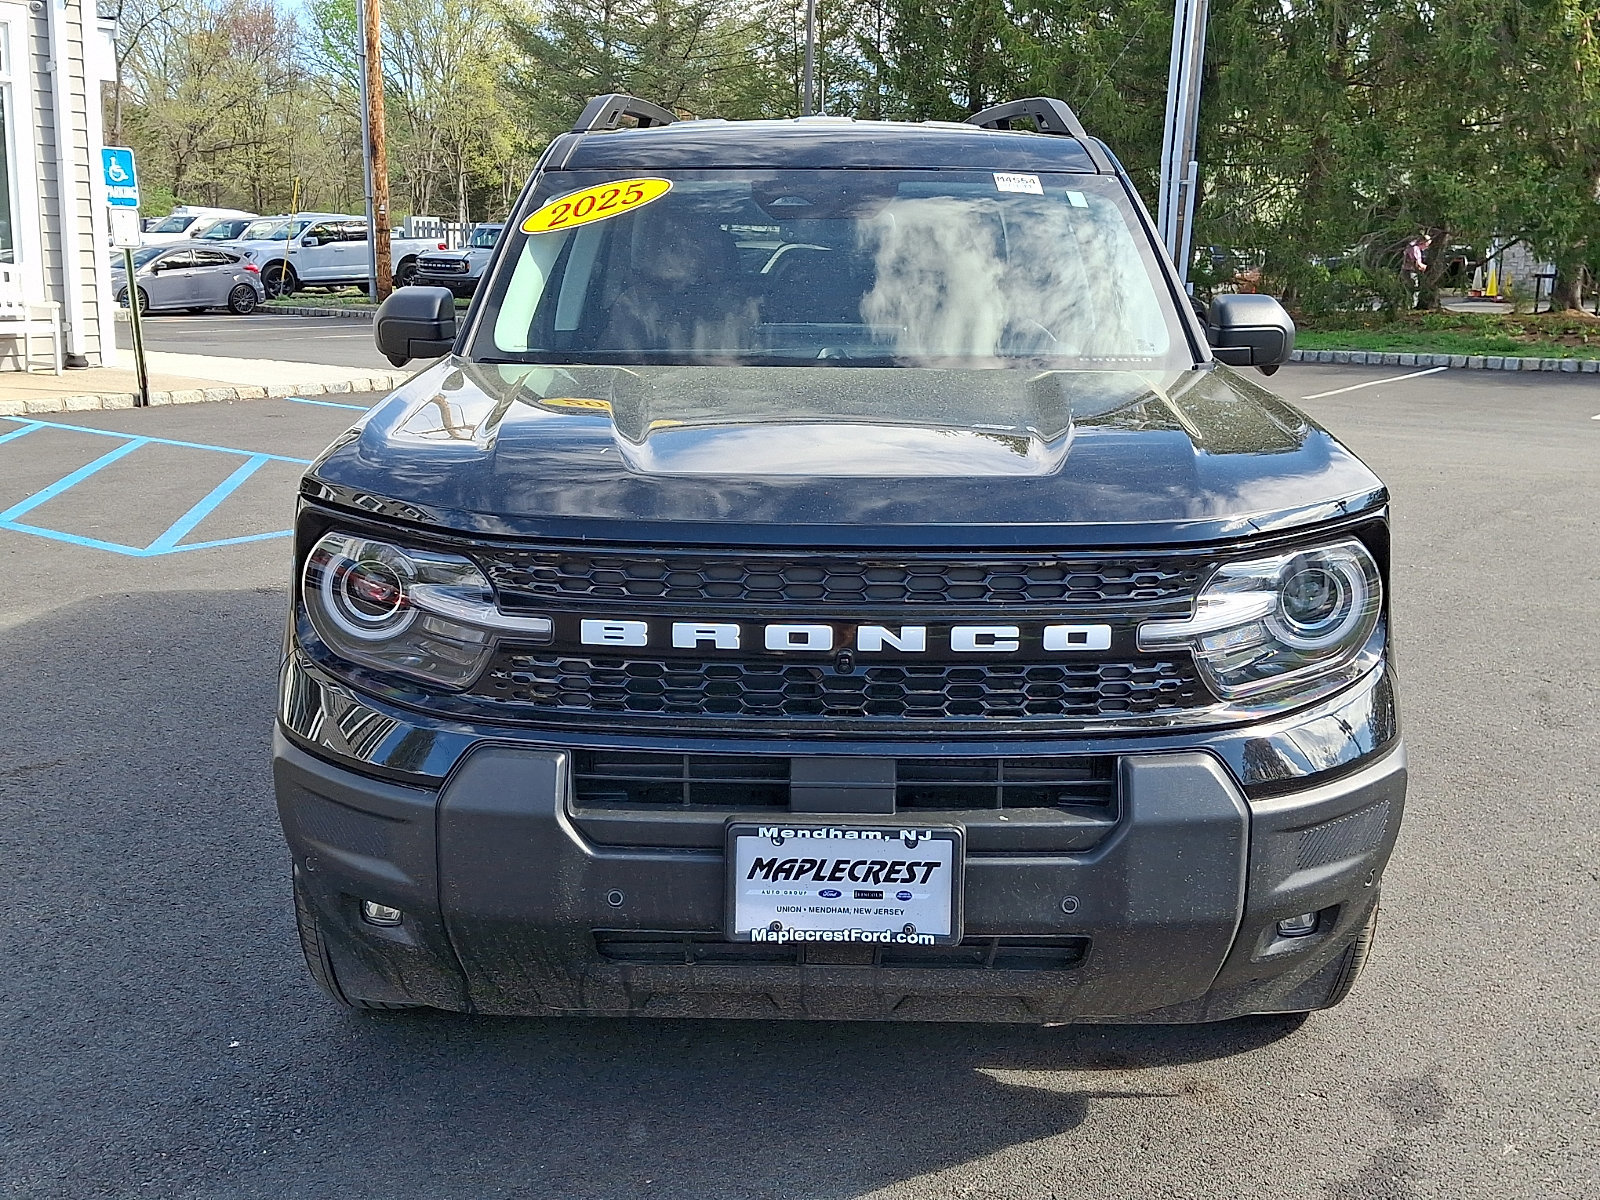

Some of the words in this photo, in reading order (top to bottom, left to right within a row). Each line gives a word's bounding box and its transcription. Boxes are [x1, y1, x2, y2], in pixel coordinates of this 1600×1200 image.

[548, 183, 645, 227] 2025
[580, 619, 1112, 652] BRONCO
[758, 827, 890, 842] Mendham,
[900, 829, 932, 841] NJ
[747, 857, 942, 885] MAPLECREST
[776, 905, 802, 913] UNION
[808, 906, 852, 914] MENDHAM,
[853, 907, 872, 915] NEW
[873, 907, 905, 916] JERSEY
[751, 928, 936, 945] MaplecrestFord.com
